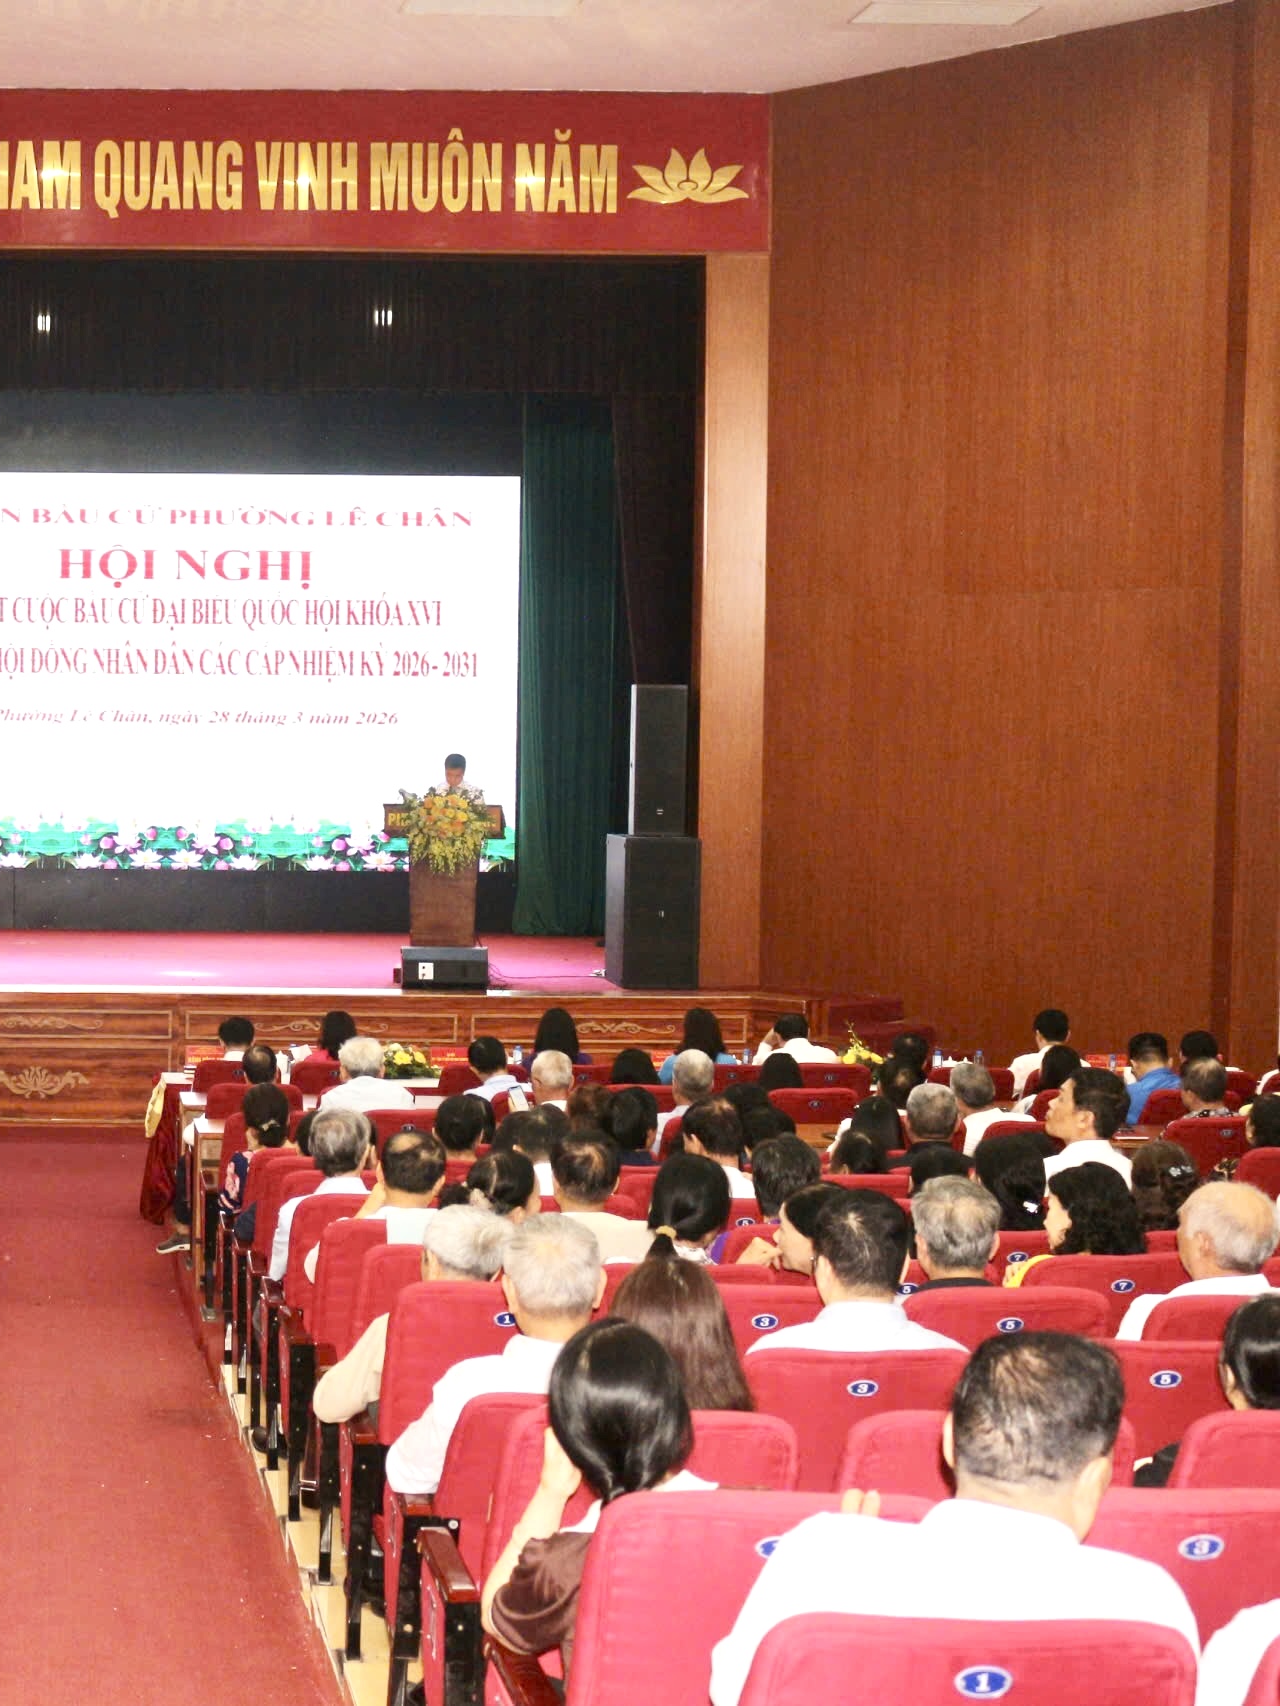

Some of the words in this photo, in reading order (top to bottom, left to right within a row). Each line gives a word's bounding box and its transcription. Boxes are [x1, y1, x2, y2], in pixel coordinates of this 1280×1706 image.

[93, 139, 243, 218] QUANG
[255, 140, 358, 211] VINH
[369, 127, 502, 213] MUÔN
[514, 128, 618, 213] NĂM
[169, 505, 315, 526] PHƯỜNG
[325, 506, 368, 527] LÊ
[375, 506, 473, 527] CHÂN
[58, 544, 158, 588] HỘI
[175, 549, 314, 591] NGHỊ
[151, 597, 186, 631] ĐẠI
[304, 596, 341, 633] HỘI
[346, 591, 404, 627] KHÓA
[407, 600, 442, 627] XVI
[92, 640, 149, 675] NHÂN
[153, 640, 195, 675] DÂN
[199, 640, 241, 676] CÁC
[288, 646, 355, 684] NHIỆM
[208, 710, 231, 724] 28
[355, 711, 399, 725] 2026
